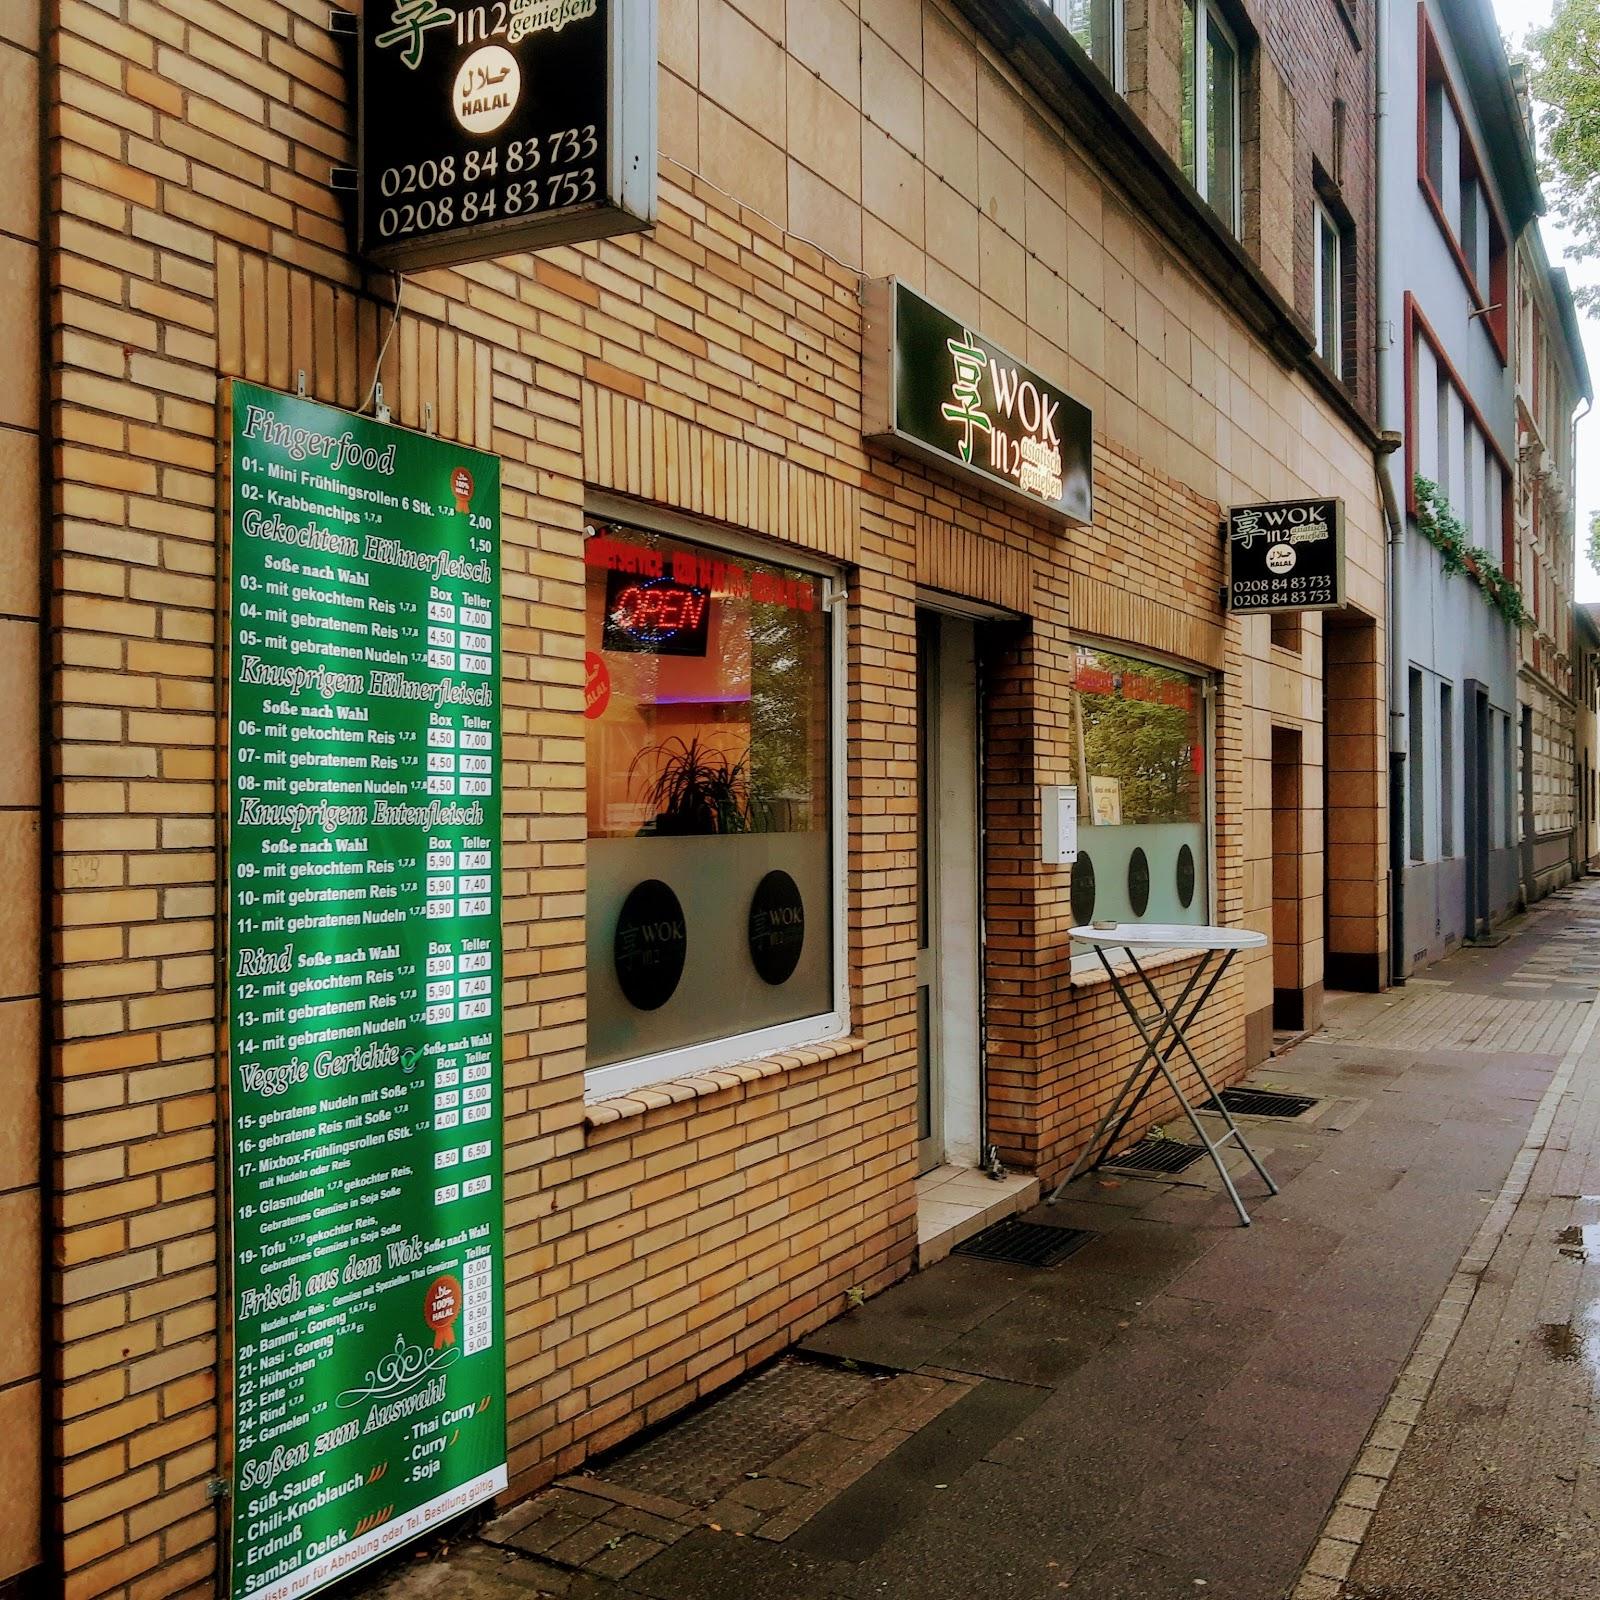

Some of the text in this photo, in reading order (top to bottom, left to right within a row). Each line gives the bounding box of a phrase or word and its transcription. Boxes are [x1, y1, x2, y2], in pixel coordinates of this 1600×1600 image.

[512, 0, 590, 39] genießen
[463, 65, 511, 97] حلال
[462, 93, 510, 116] HALAL
[381, 124, 597, 197] 0208 84 83 733
[379, 167, 596, 237] 0208 84 83 753
[941, 328, 991, 464] 享
[990, 358, 1060, 446] WOK
[243, 405, 396, 475] Fingerfood
[242, 456, 492, 530] 01- Mini Frühlingsrollen 6 Stk. 2,00
[242, 484, 264, 499] 02-
[268, 490, 360, 524] Krabbenchips
[469, 537, 492, 553] 1,50
[1231, 510, 1267, 549] 享
[1264, 505, 1326, 526] WOK
[242, 509, 491, 584] Gekochtem Hühnerfleisch
[265, 555, 369, 587] Soße nach Wahl
[1234, 575, 1331, 592] 0208 84 83 733
[240, 575, 486, 625] 03- mit gekochtem Reis 4,50 7,00
[430, 586, 491, 608] Box Teller
[620, 587, 705, 628] OPEN
[1234, 590, 1331, 606] 0208 84 83 753
[240, 630, 486, 671] 05- mit gebratenen Nudeln 4,50 7,00
[240, 655, 492, 708] Knusprigem Hühnerfleisch
[263, 700, 368, 721] Soße nach Wahl
[429, 713, 491, 730] Box Teller
[239, 721, 486, 746] 06- mit gekochtem Reis 4,50 7,00
[238, 797, 483, 833] Knusprigem Entenfleisch
[262, 838, 368, 853] Soße nach Wahl
[429, 836, 490, 850] Box Teller
[237, 855, 486, 879] 09- mit gekochtem Reis 5,90 7,40
[642, 921, 683, 942] WOK
[770, 907, 802, 925] WOK
[237, 938, 491, 977] Rind Soße nach Wahl Box Teller
[240, 1042, 399, 1097] Veggie Gerichte
[238, 1067, 486, 1130] 15- gebratene Nudeln mit Soße 3,50 5,00
[238, 1107, 486, 1177] 17- Mixbox-Frühlingsrollen 6Stk. 4,00 6,00
[239, 1186, 324, 1220] 18- Glasnudeln
[239, 1241, 286, 1265] 19- Tofu
[239, 1234, 423, 1320] Frisch aus dem Wok
[239, 1327, 298, 1360] 20- Bammi
[239, 1359, 315, 1397] 22- Hühnchen
[239, 1388, 286, 1415] 23- Ente
[239, 1403, 286, 1434] 24- Rind
[412, 1402, 476, 1440] Thai Curry
[239, 1413, 309, 1452] 25- Garnelen
[240, 1375, 447, 1491] Soßen zum Auswahl
[412, 1435, 447, 1461] Curry
[412, 1459, 440, 1484] Soja
[248, 1470, 326, 1518] Süß-Sauer
[248, 1473, 363, 1542] Chili-Knoblauch
[247, 1526, 302, 1565] Erdnuß
[292, 1574, 310, 1593] nur
[313, 1563, 328, 1580] für
[330, 1538, 379, 1572] Abholung
[383, 1525, 403, 1543] oder
[406, 1515, 421, 1530] Tel.
[469, 1480, 493, 1501] gültig
[245, 1551, 301, 1594] Sambal
[306, 1529, 347, 1560] Oelek
